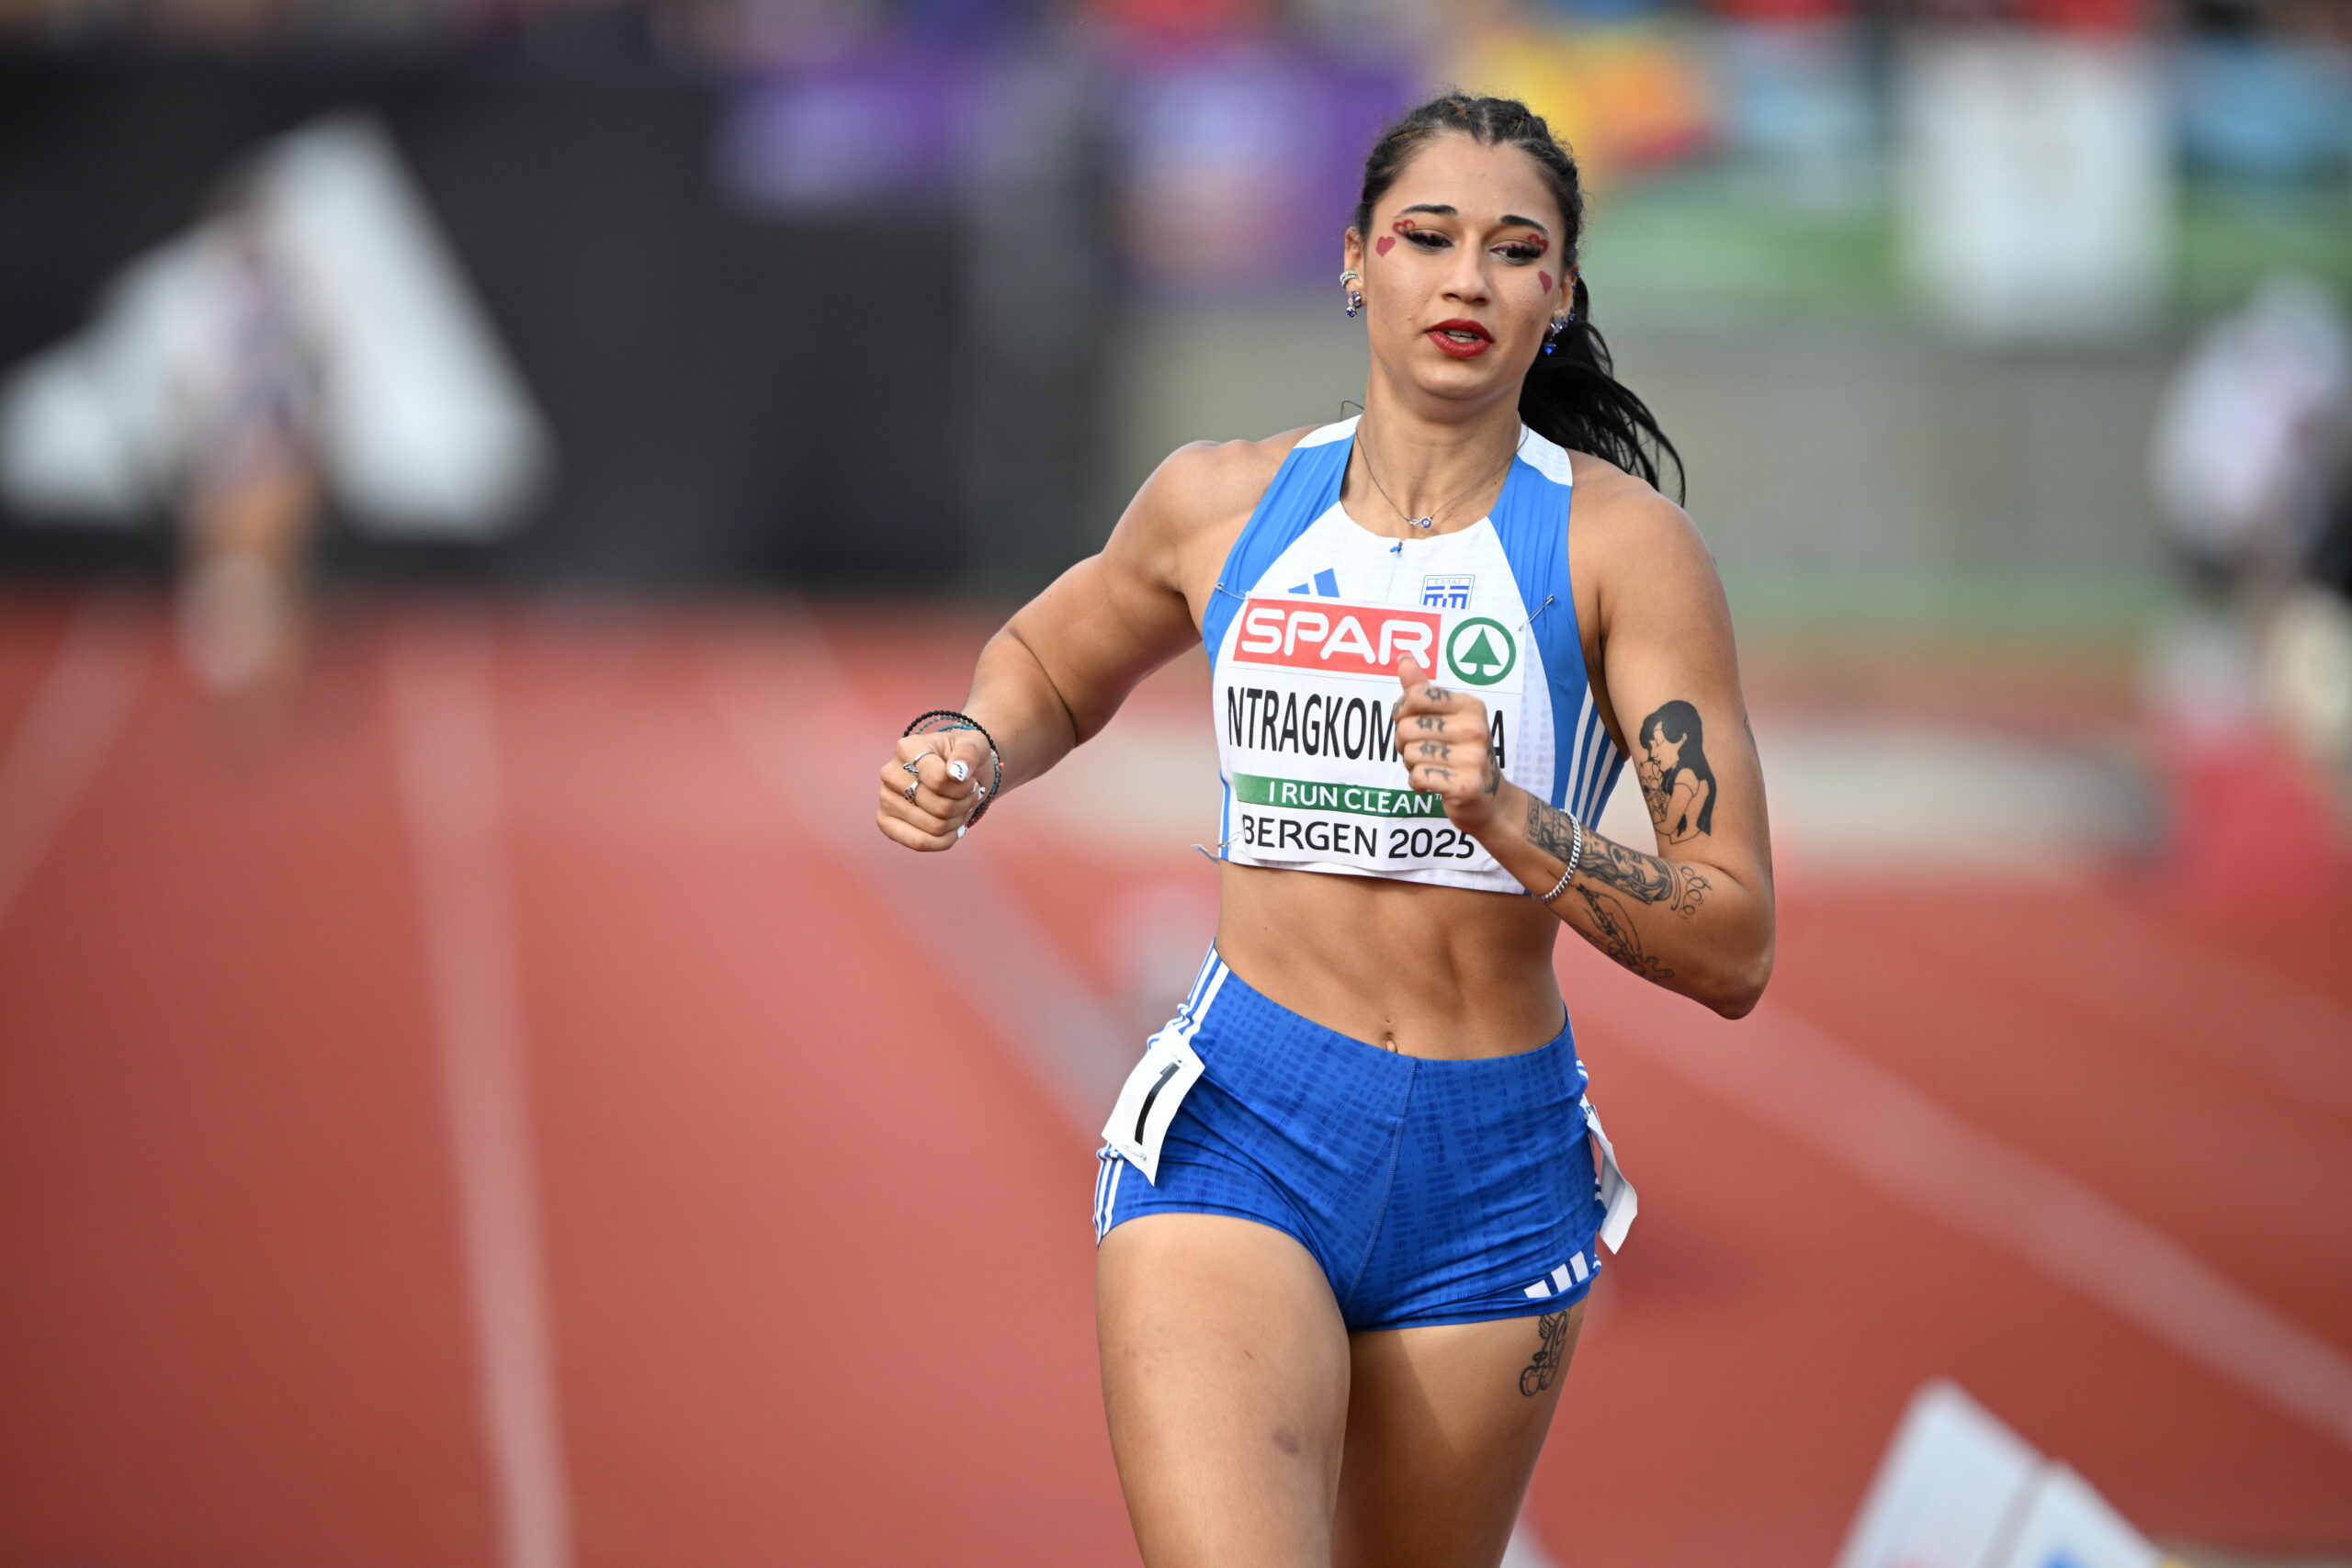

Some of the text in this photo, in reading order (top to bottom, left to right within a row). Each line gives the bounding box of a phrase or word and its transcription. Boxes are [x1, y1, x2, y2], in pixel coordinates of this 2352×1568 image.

[1241, 607, 1432, 669] SPAR
[1227, 686, 1505, 769] NTRAGKOMA
[1269, 781, 1275, 802] I
[1282, 783, 1338, 807] RUN
[1242, 814, 1475, 859] BERGEN 2025
[1134, 1062, 1181, 1146] 1
